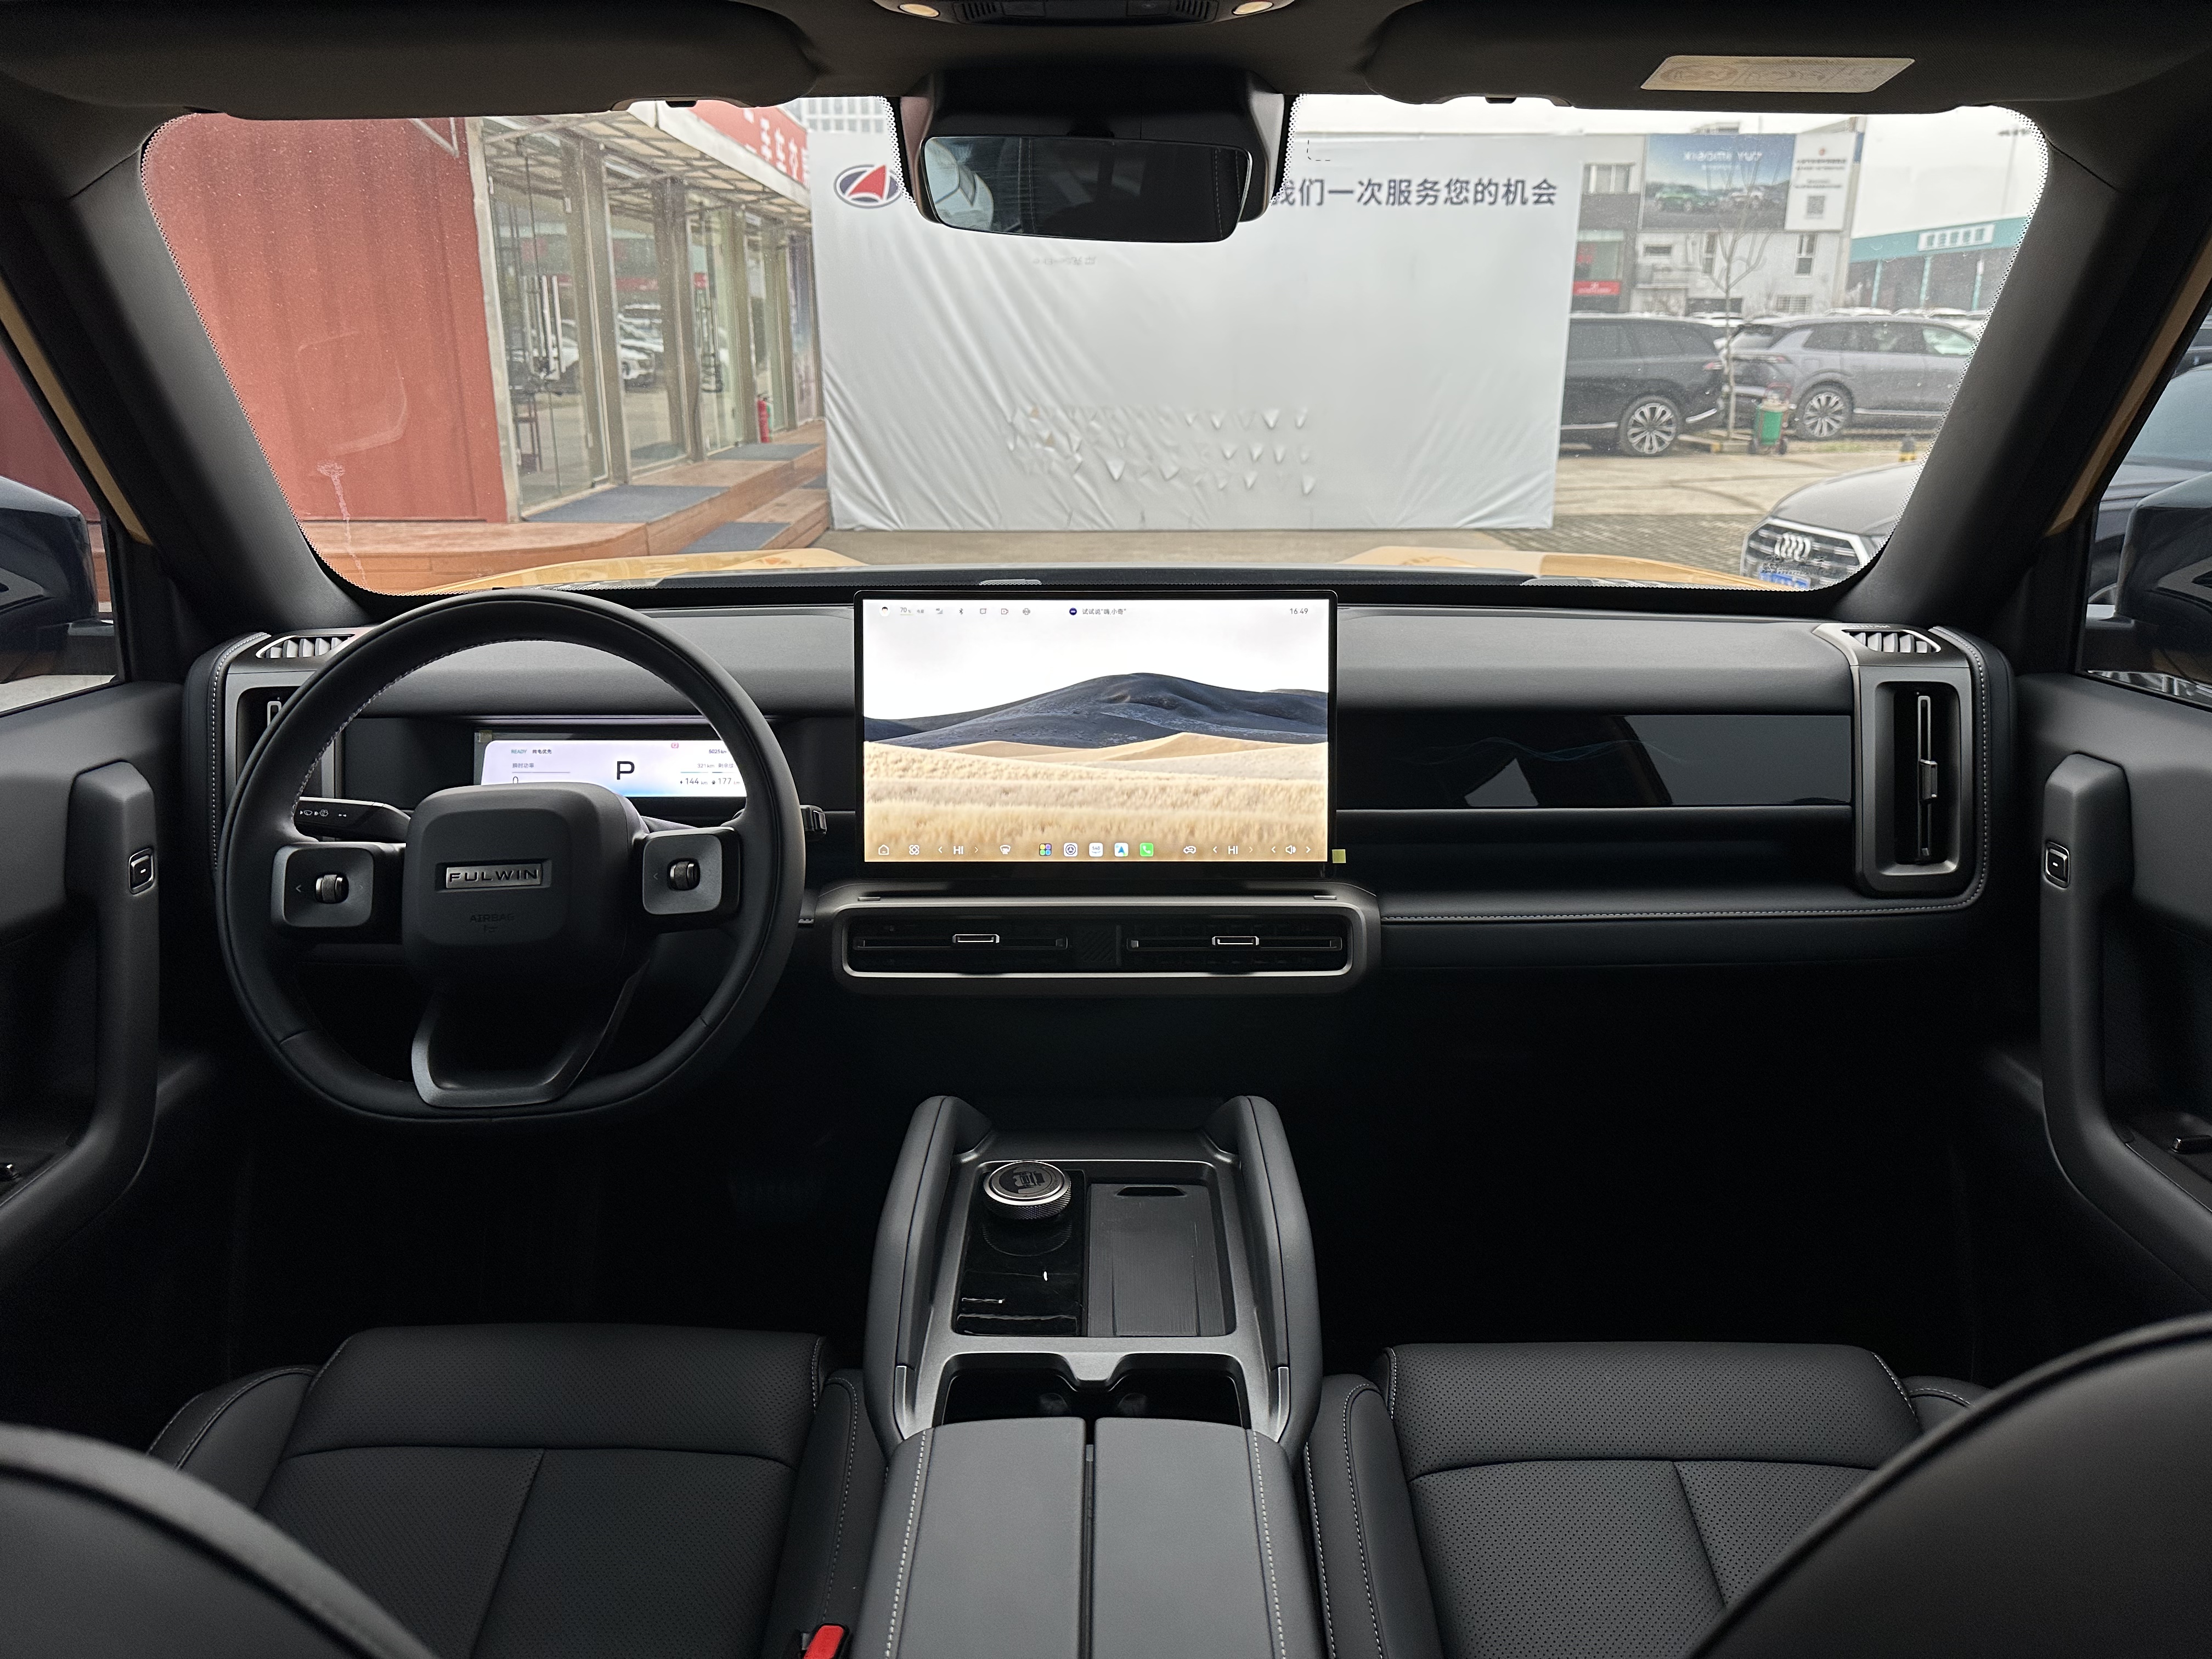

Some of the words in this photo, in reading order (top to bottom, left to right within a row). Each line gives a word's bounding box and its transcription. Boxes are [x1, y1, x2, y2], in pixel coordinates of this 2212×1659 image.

[617, 761, 635, 780] P
[953, 845, 964, 855] HI
[1228, 845, 1238, 855] HI
[449, 870, 539, 883] FULWIN
